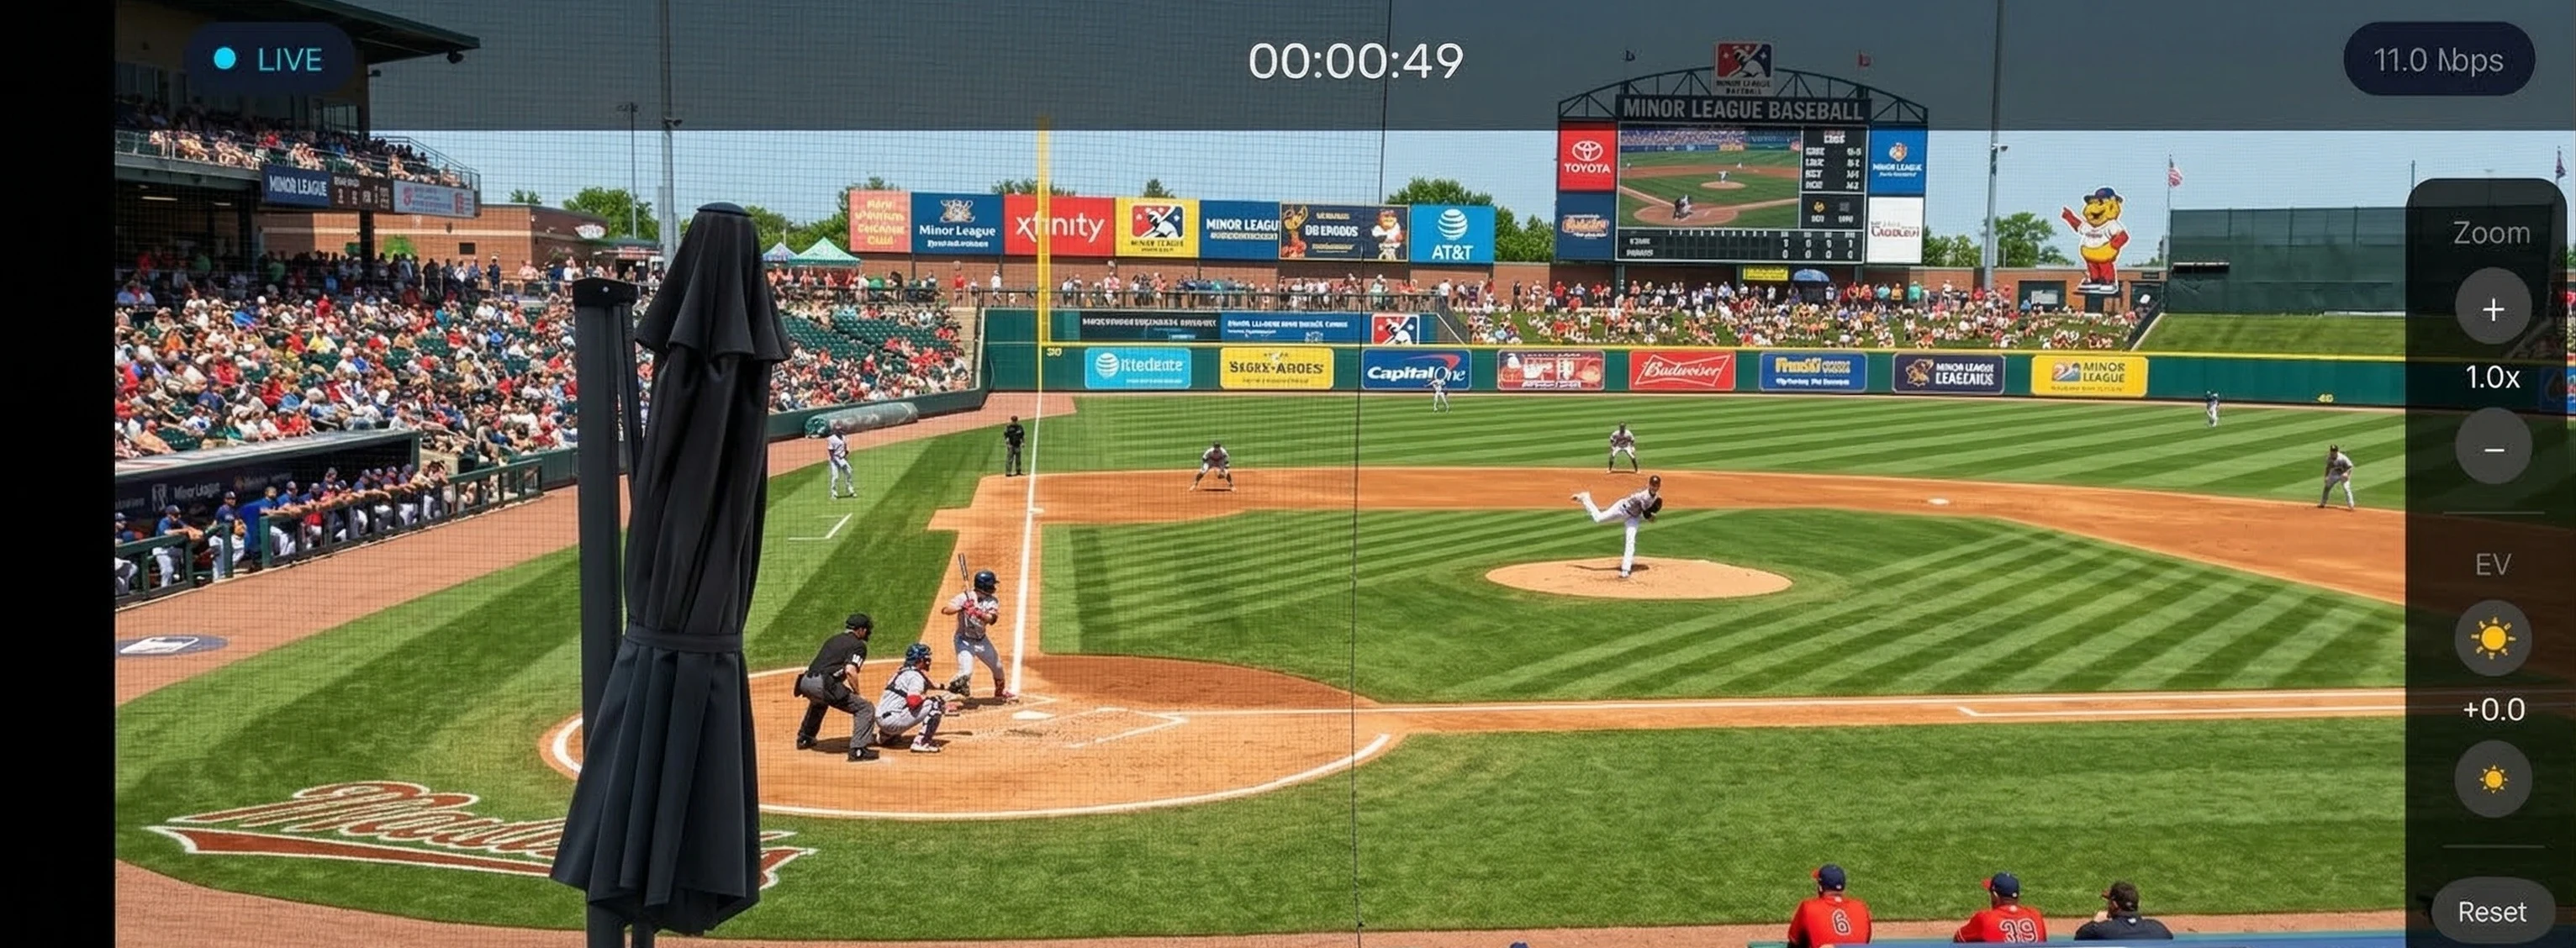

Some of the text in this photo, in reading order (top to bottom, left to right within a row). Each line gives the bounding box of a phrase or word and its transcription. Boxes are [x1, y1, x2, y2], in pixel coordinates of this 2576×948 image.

[1623, 97, 1864, 121] MINOR LEAGUE BASEBALL
[1564, 163, 1612, 174] TOYOTA
[919, 224, 997, 239] Minor League
[1206, 218, 1280, 231] MINOR LEAGU
[1431, 244, 1475, 261] AT&T
[1644, 361, 1720, 378] Budweiser
[2083, 362, 2126, 372] MINOR
[2083, 372, 2125, 383] LEAGUE
[1831, 908, 1851, 936] 6
